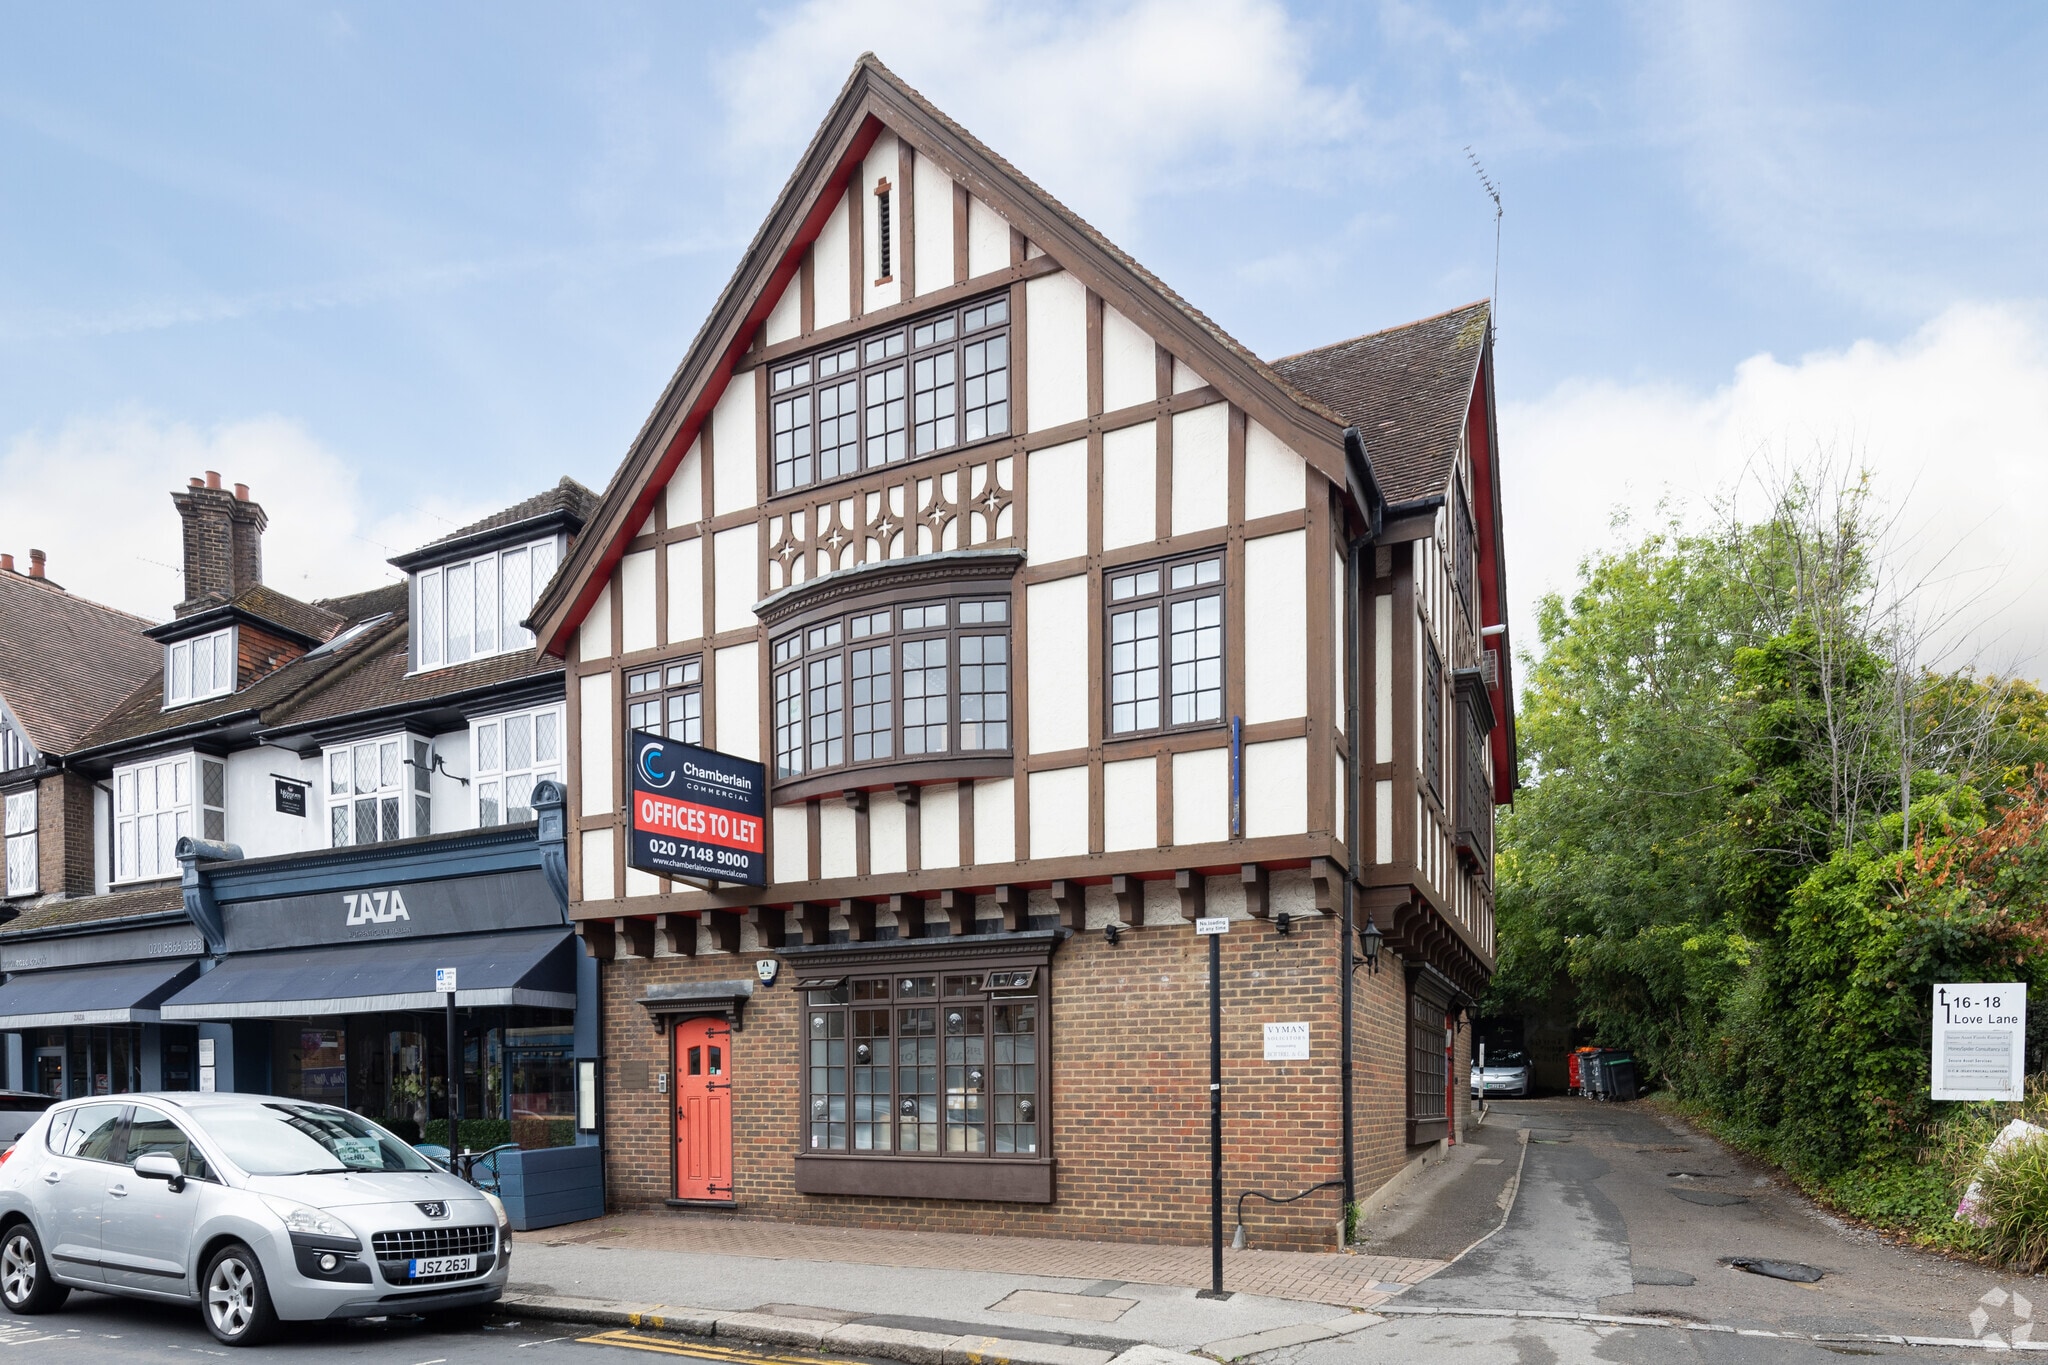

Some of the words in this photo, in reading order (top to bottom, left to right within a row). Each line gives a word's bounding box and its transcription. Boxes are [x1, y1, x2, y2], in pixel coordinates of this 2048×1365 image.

[683, 762, 752, 790] Chamberlain
[686, 782, 749, 802] COMMERCIAL
[642, 798, 706, 834] OFFICES
[709, 813, 729, 838] TO
[732, 818, 756, 844] LET
[650, 838, 676, 856] 020
[680, 844, 714, 862] 7148
[717, 852, 749, 868] 9000
[652, 858, 748, 879] www.chamberlaincommercial.com
[342, 890, 410, 926] ZAZA
[148, 942, 162, 954] 020
[1954, 996, 1971, 1008] 16
[1984, 996, 2001, 1008] 18
[1267, 1025, 1305, 1033] VYMAN
[1954, 1014, 1983, 1024] Love
[1989, 1014, 2018, 1024] Lane
[418, 1261, 442, 1275] JSZ
[445, 1258, 470, 1272] 2631
